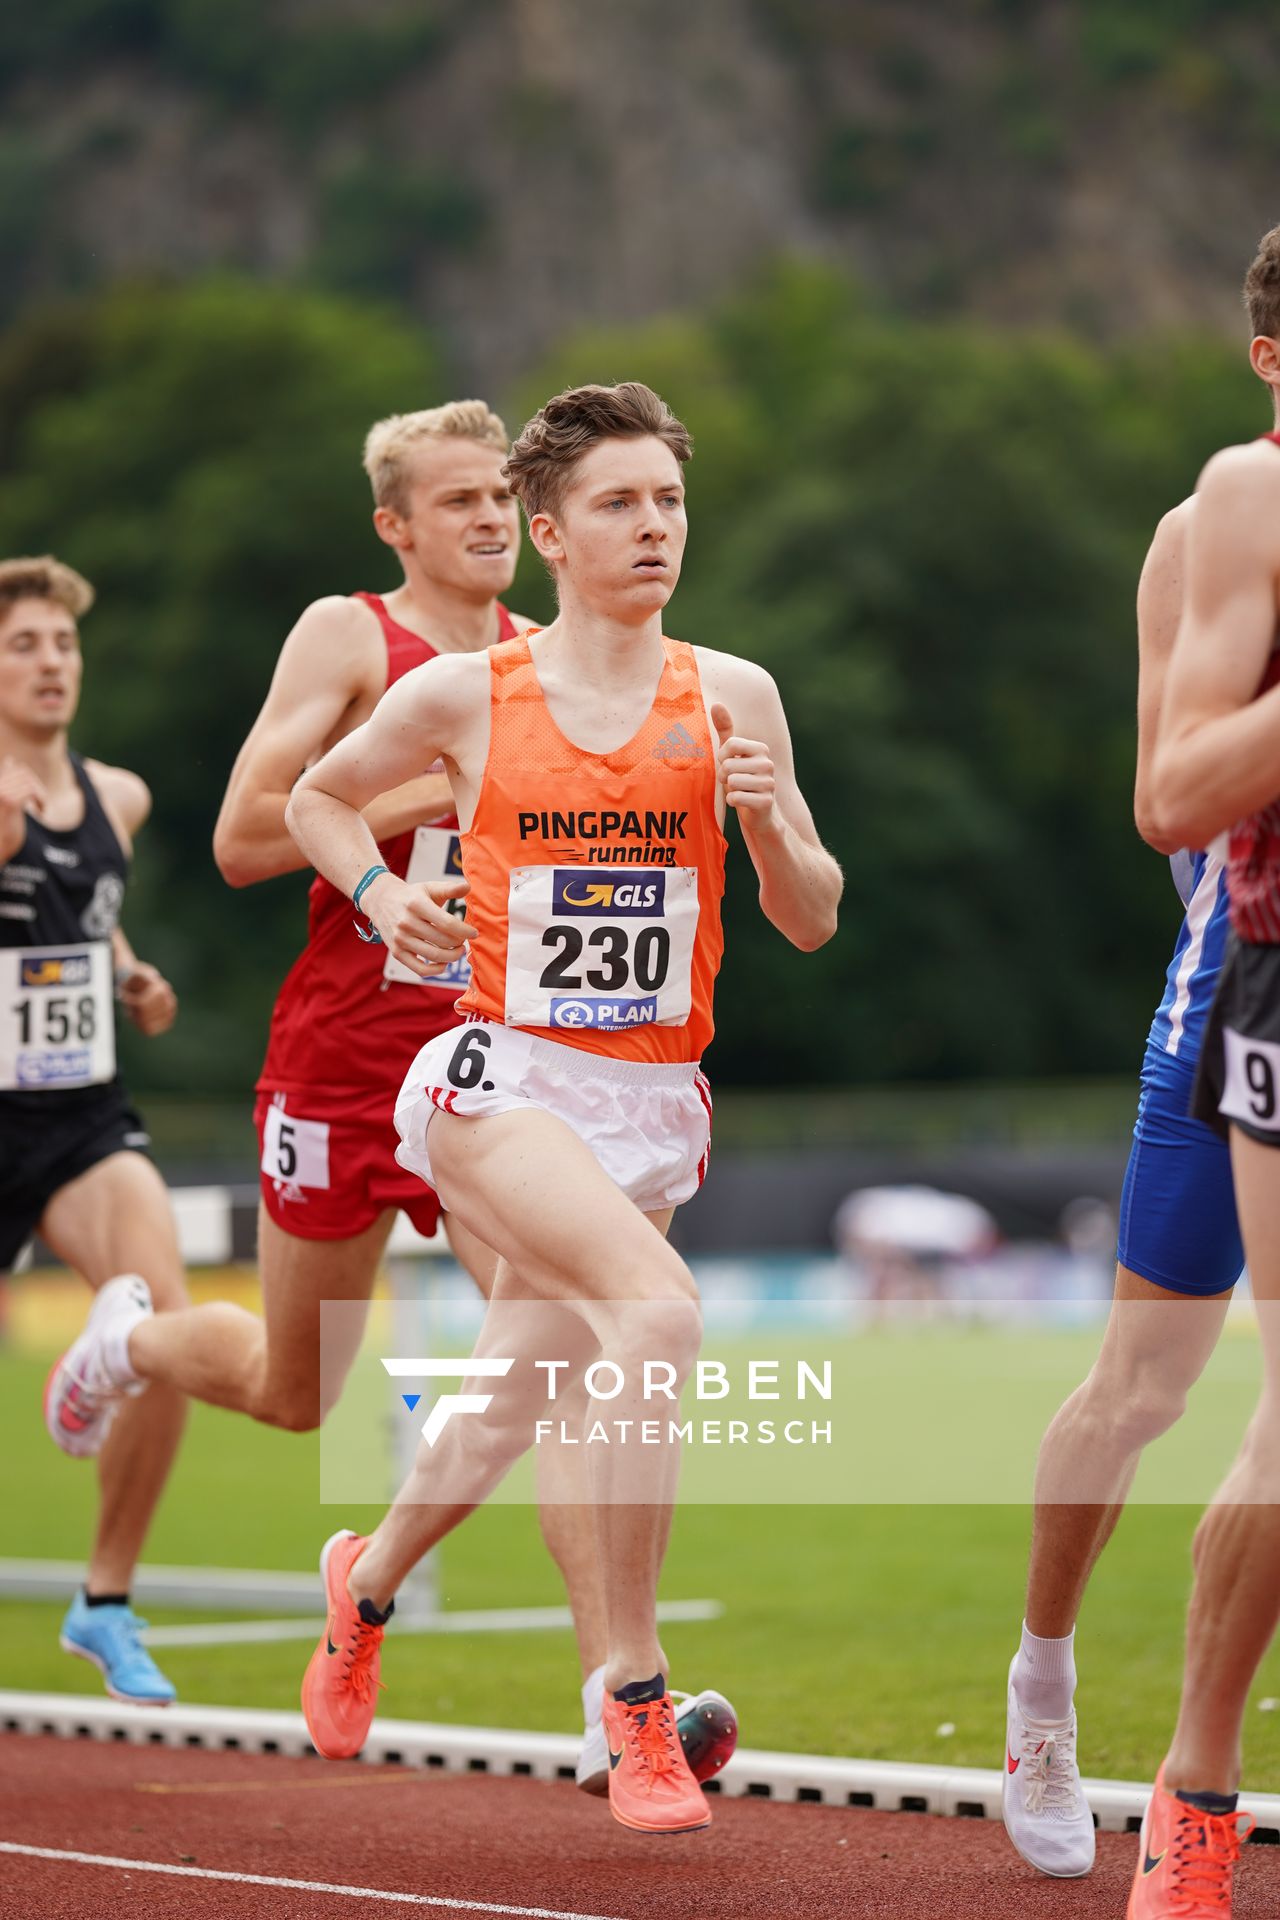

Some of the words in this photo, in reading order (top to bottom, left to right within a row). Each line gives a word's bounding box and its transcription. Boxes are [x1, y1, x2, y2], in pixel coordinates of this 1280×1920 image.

[518, 811, 689, 840] PINGPANK
[588, 841, 676, 867] running
[613, 884, 657, 908] GLS
[539, 925, 671, 992] 230
[14, 995, 96, 1046] 158
[597, 1005, 654, 1023] PLAN
[447, 1028, 495, 1092] 6.
[1246, 1051, 1275, 1120] 9
[278, 1123, 297, 1177] 5
